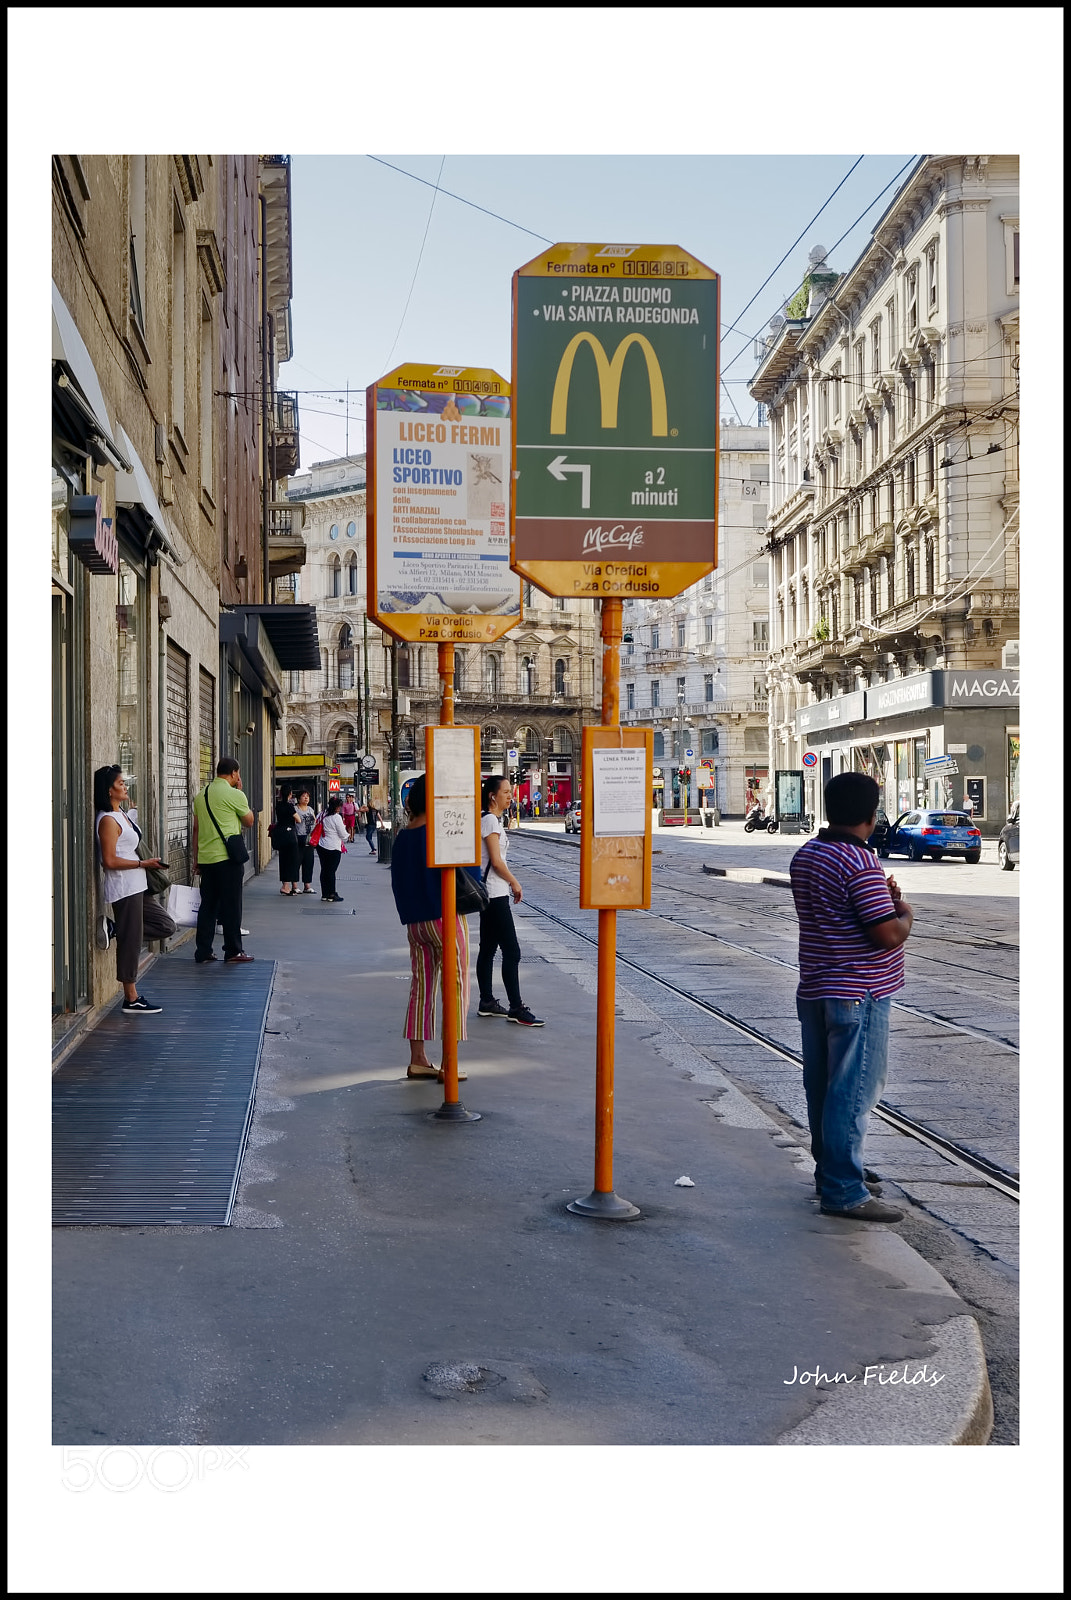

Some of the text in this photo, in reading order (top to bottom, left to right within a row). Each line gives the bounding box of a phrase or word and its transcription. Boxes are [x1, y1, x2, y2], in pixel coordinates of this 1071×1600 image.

[546, 261, 688, 275] Fermata n° 11491
[571, 285, 671, 304] PIAZZA DUOMO
[543, 304, 699, 324] VIA SANTA RADEGONDA
[397, 377, 436, 388] Fermata
[454, 379, 500, 393] 11491
[399, 422, 501, 446] LICEO FERMI
[393, 447, 432, 466] LICEO
[393, 466, 463, 486] SPORTIVO
[645, 467, 665, 485] a 2
[407, 487, 457, 496] insegnamento
[631, 488, 678, 505] minuti
[392, 496, 411, 504] delle
[393, 505, 440, 515] ARTI MARZIALI
[392, 515, 400, 524] in
[401, 515, 453, 526] collaborazione
[449, 537, 466, 546] Long
[583, 524, 644, 553] McCafé
[402, 560, 420, 568] Liceo
[420, 561, 447, 570] Sportivo
[583, 564, 648, 576] Via Orefici
[574, 580, 660, 592] P.za Cordusio
[425, 616, 473, 626] Via Orefici
[419, 628, 482, 639] P.za Cordusio
[951, 678, 1019, 697] MAGAZ
